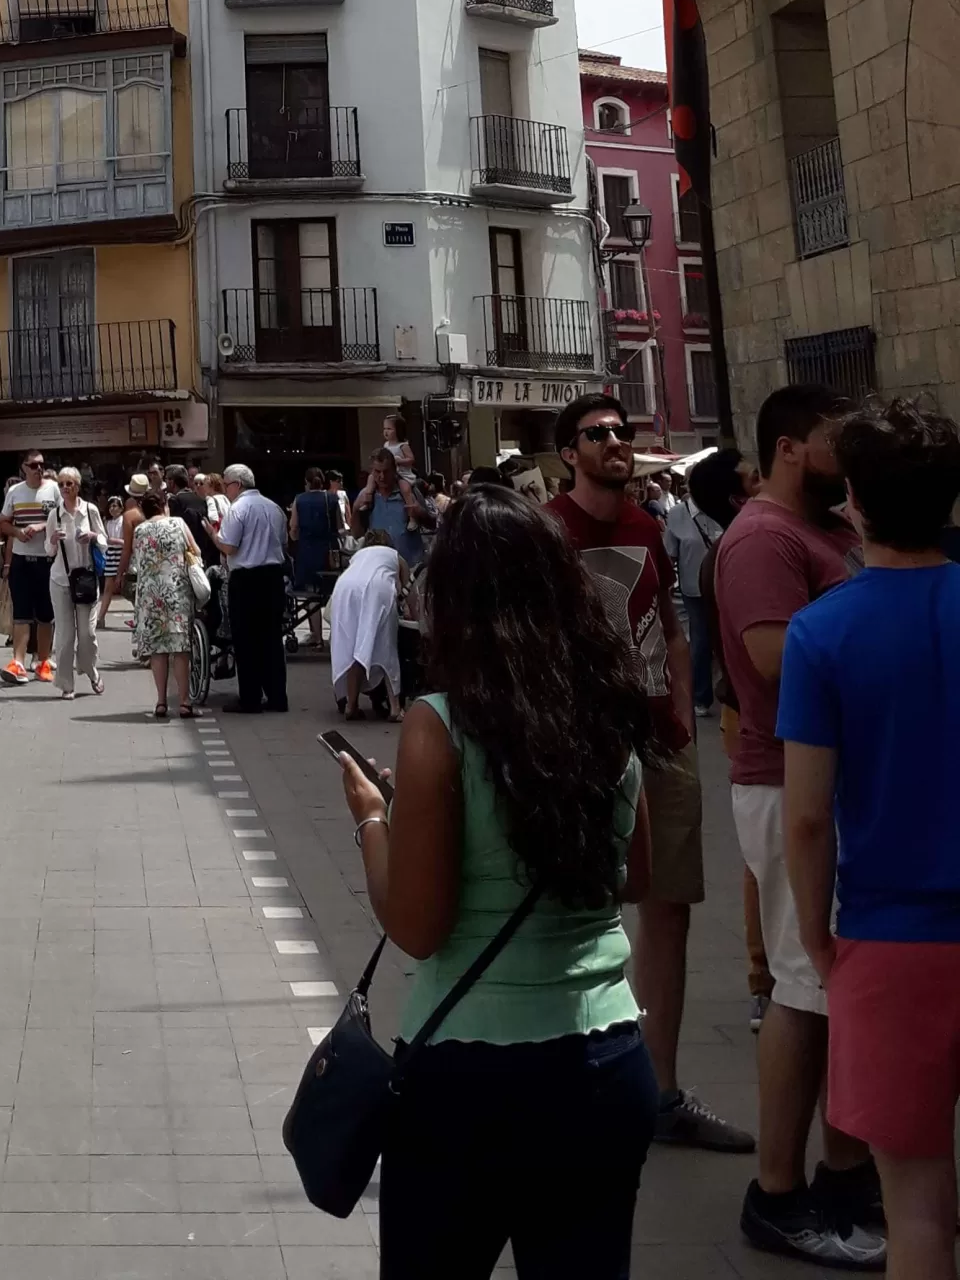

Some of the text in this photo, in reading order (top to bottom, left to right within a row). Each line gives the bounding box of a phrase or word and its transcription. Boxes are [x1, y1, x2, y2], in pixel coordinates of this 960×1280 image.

[477, 380, 582, 403] BAR LA UNION
[635, 606, 656, 643] adidas
